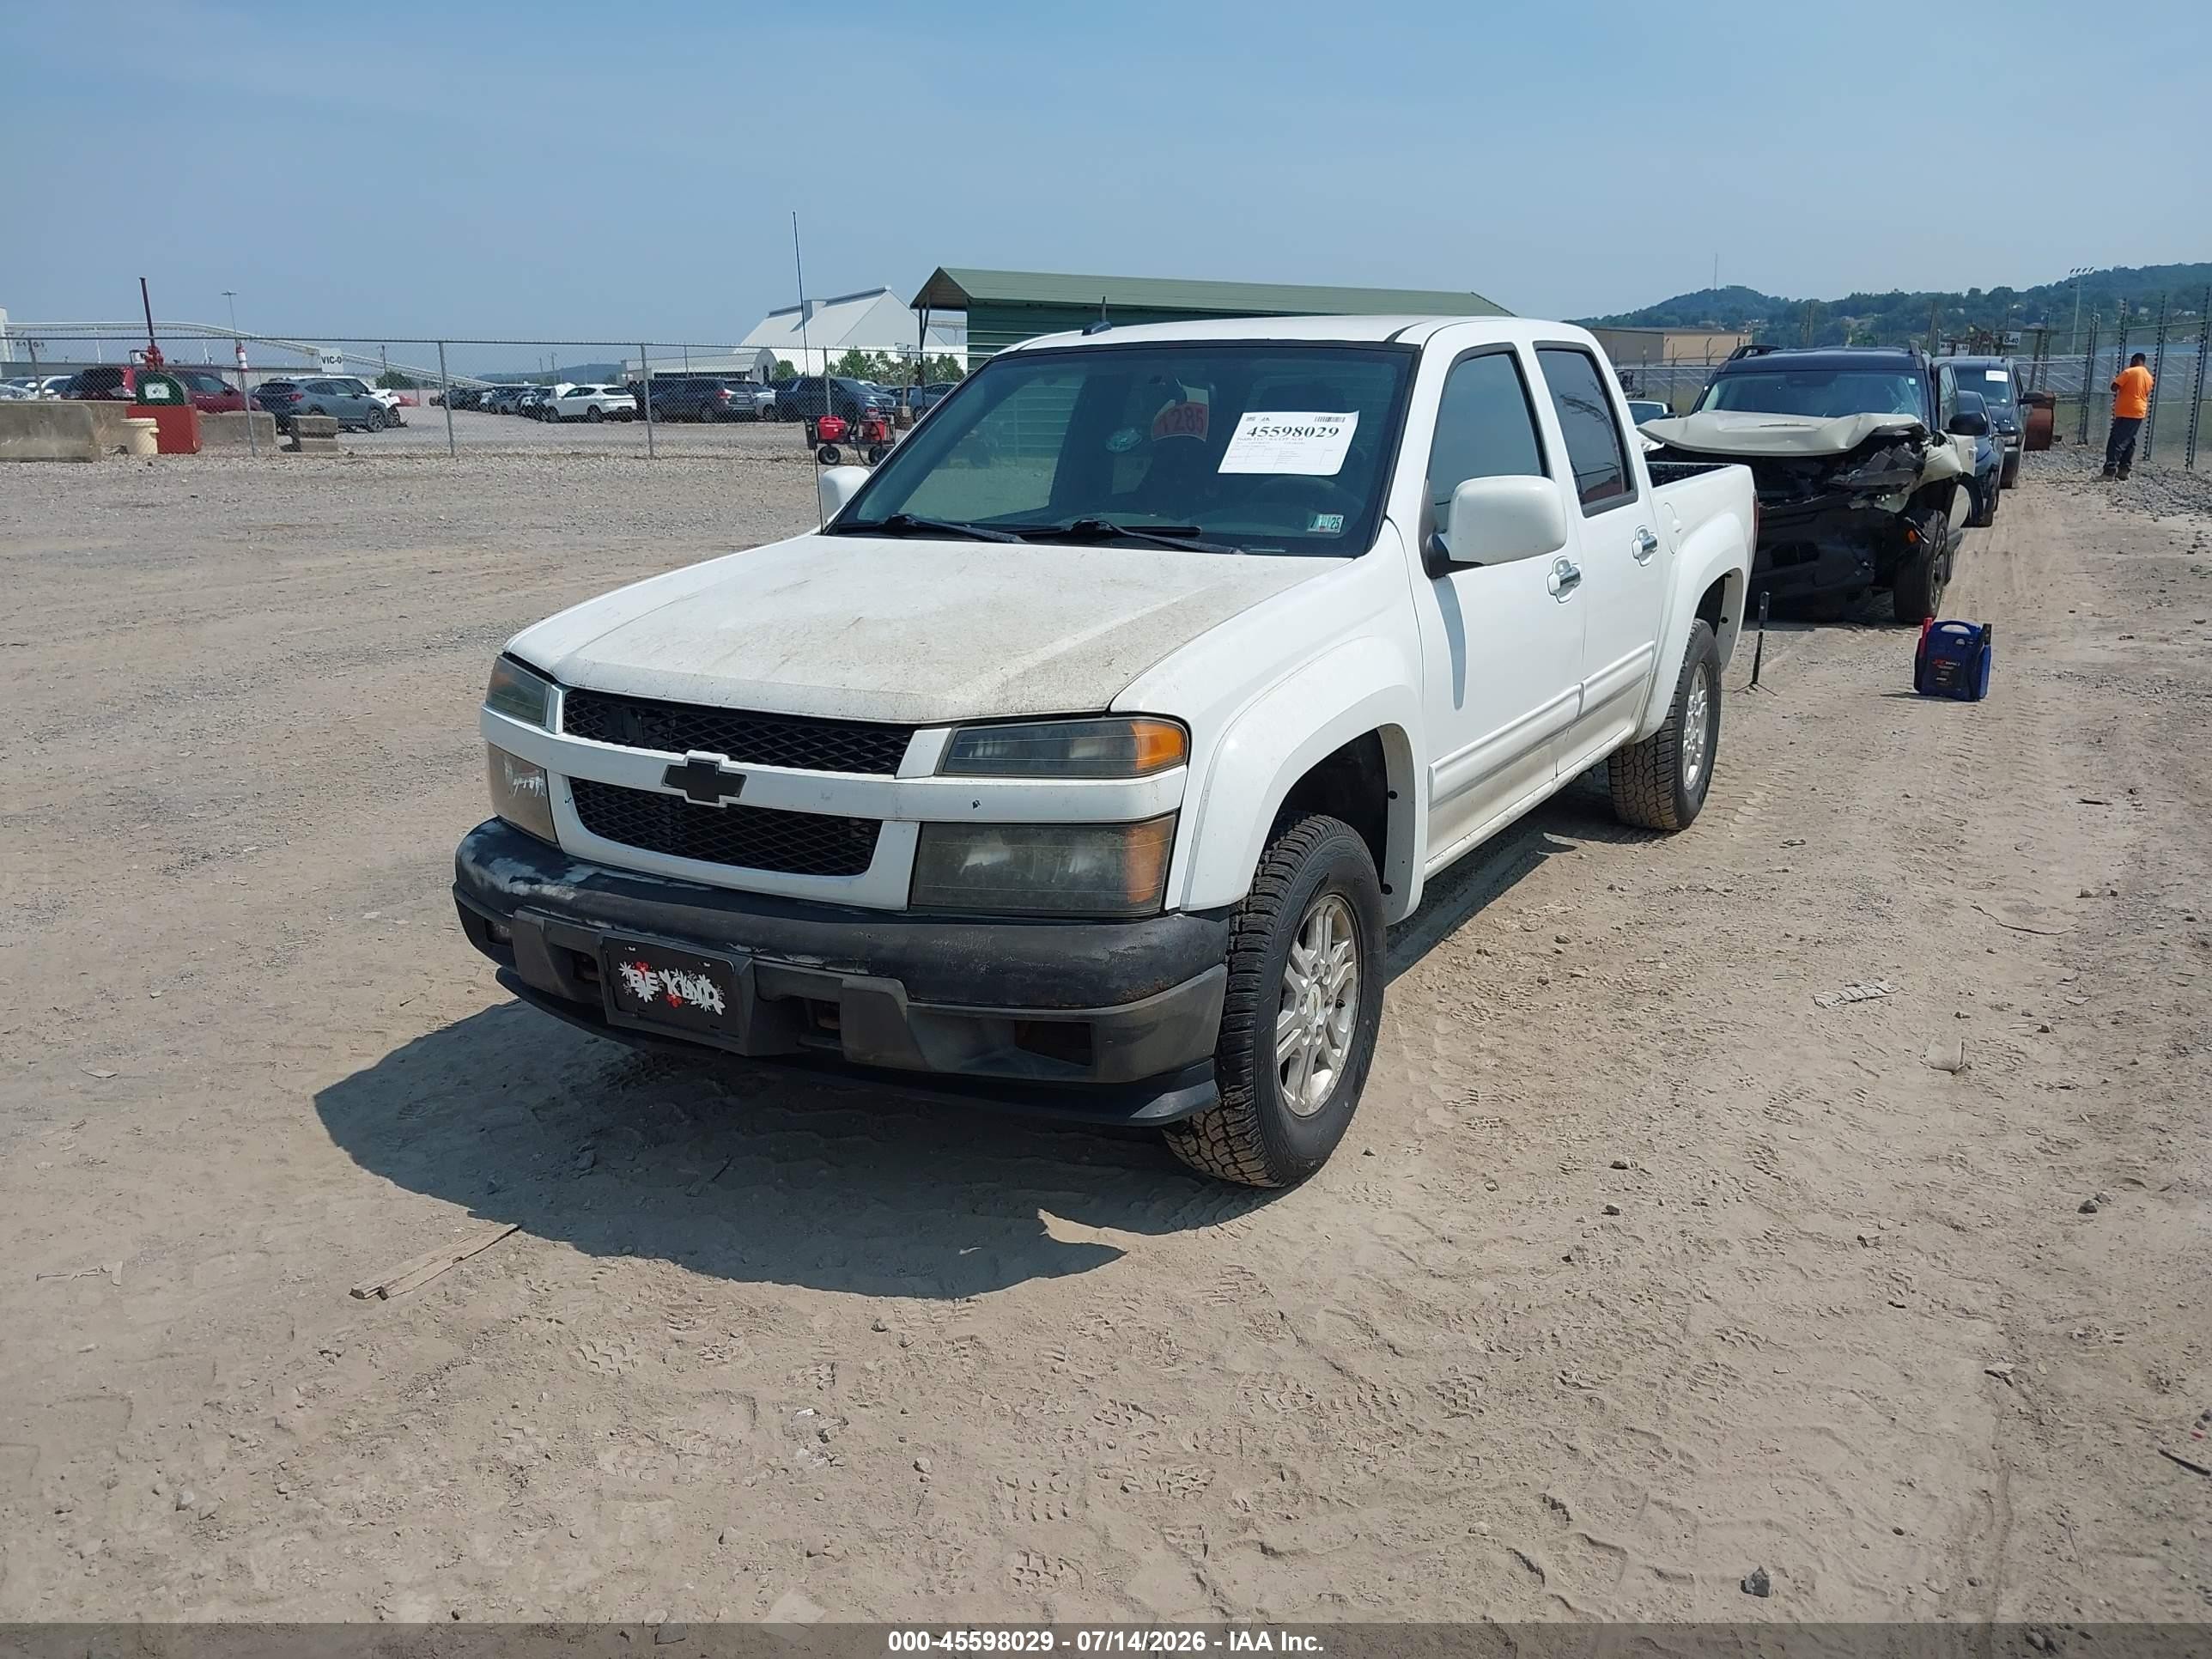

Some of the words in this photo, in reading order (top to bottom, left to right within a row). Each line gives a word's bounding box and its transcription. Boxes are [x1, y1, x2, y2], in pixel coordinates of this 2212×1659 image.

[1247, 425, 1340, 439] 45598029
[1330, 516, 1341, 530] 25
[628, 969, 659, 992] BE
